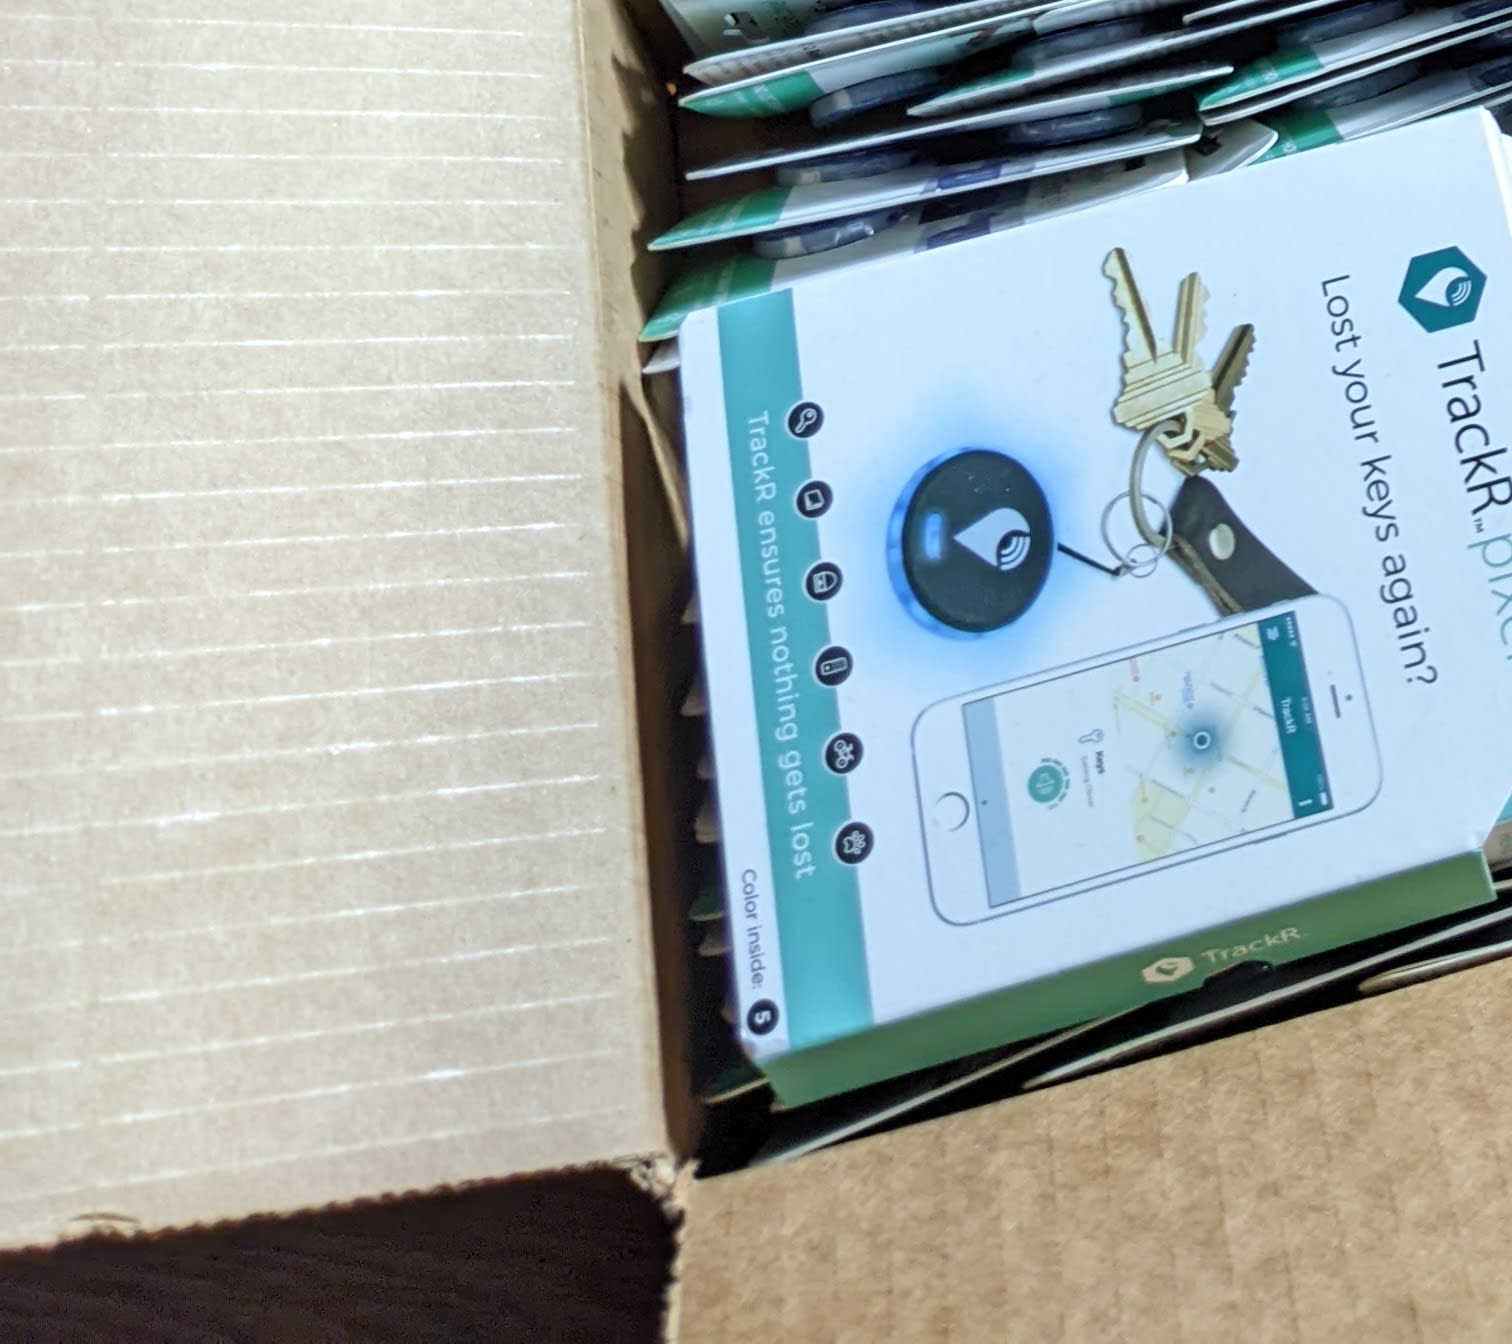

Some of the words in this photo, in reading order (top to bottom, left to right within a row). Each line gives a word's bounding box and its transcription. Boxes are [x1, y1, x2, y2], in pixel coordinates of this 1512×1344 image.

[1321, 274, 1362, 352] Lost
[1332, 358, 1379, 444] your
[748, 410, 777, 503] TrackR
[1360, 454, 1400, 542] keys
[757, 510, 785, 619] ensures
[1379, 553, 1438, 685] again?
[769, 625, 801, 741] nothing
[1281, 697, 1297, 734] TrackR
[778, 749, 808, 815] gets
[789, 821, 816, 880] lost
[741, 868, 759, 921] Color
[747, 926, 765, 991] inside:
[1201, 927, 1300, 965] TrackR
